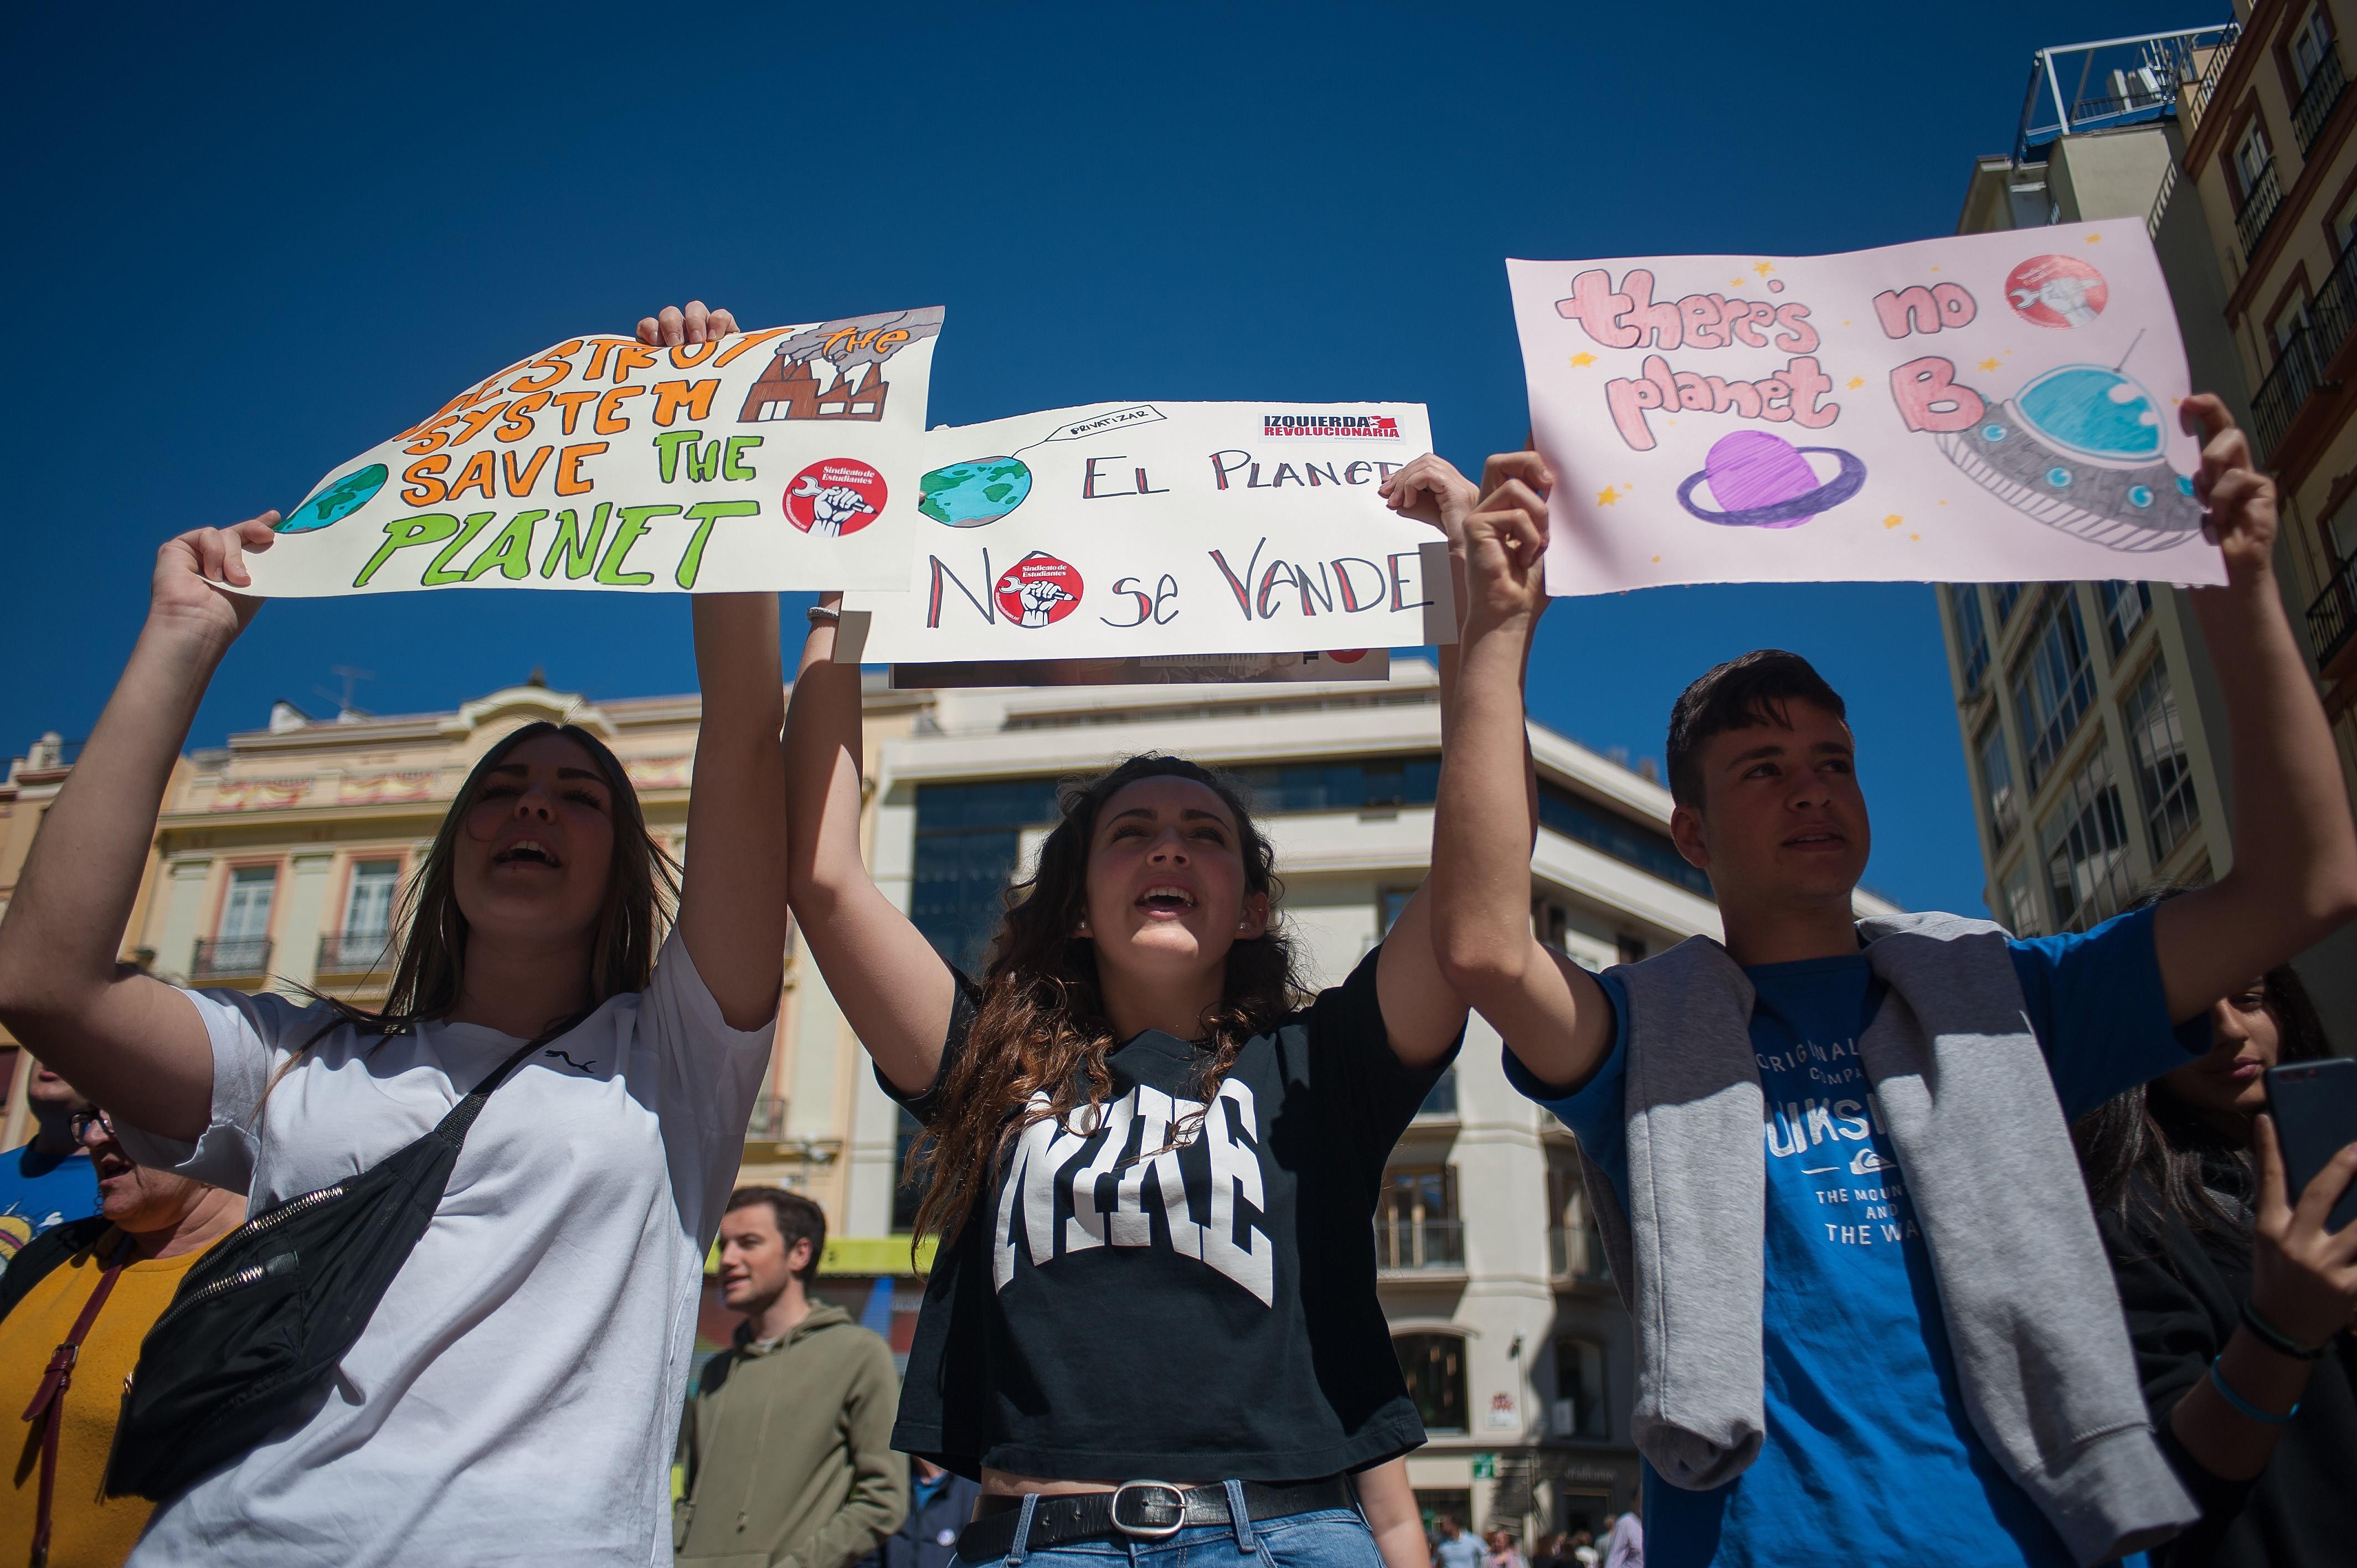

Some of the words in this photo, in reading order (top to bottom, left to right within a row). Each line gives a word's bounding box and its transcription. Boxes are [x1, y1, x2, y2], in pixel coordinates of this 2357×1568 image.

[1872, 282, 1977, 340] no
[818, 324, 911, 363] THE
[402, 379, 722, 455] SYSTEM
[1604, 354, 1841, 451] planet
[1890, 355, 1985, 435] B
[1071, 411, 1149, 435] PRIVATIZAR
[1264, 415, 1370, 427] IZQUIERDA
[1264, 427, 1400, 437] REVOLUCIONARIA
[401, 442, 609, 507] SAVE
[653, 430, 763, 482] THE
[822, 473, 873, 485] Estudiantes
[824, 466, 862, 476] Sindicato
[353, 501, 760, 589] PLANET
[1755, 1038, 1860, 1072] ORIGINAL
[994, 1077, 1273, 1308] NIKE
[1815, 1188, 1849, 1204] THE
[1866, 1203, 1900, 1220] AND
[1824, 1223, 1872, 1245] THE
